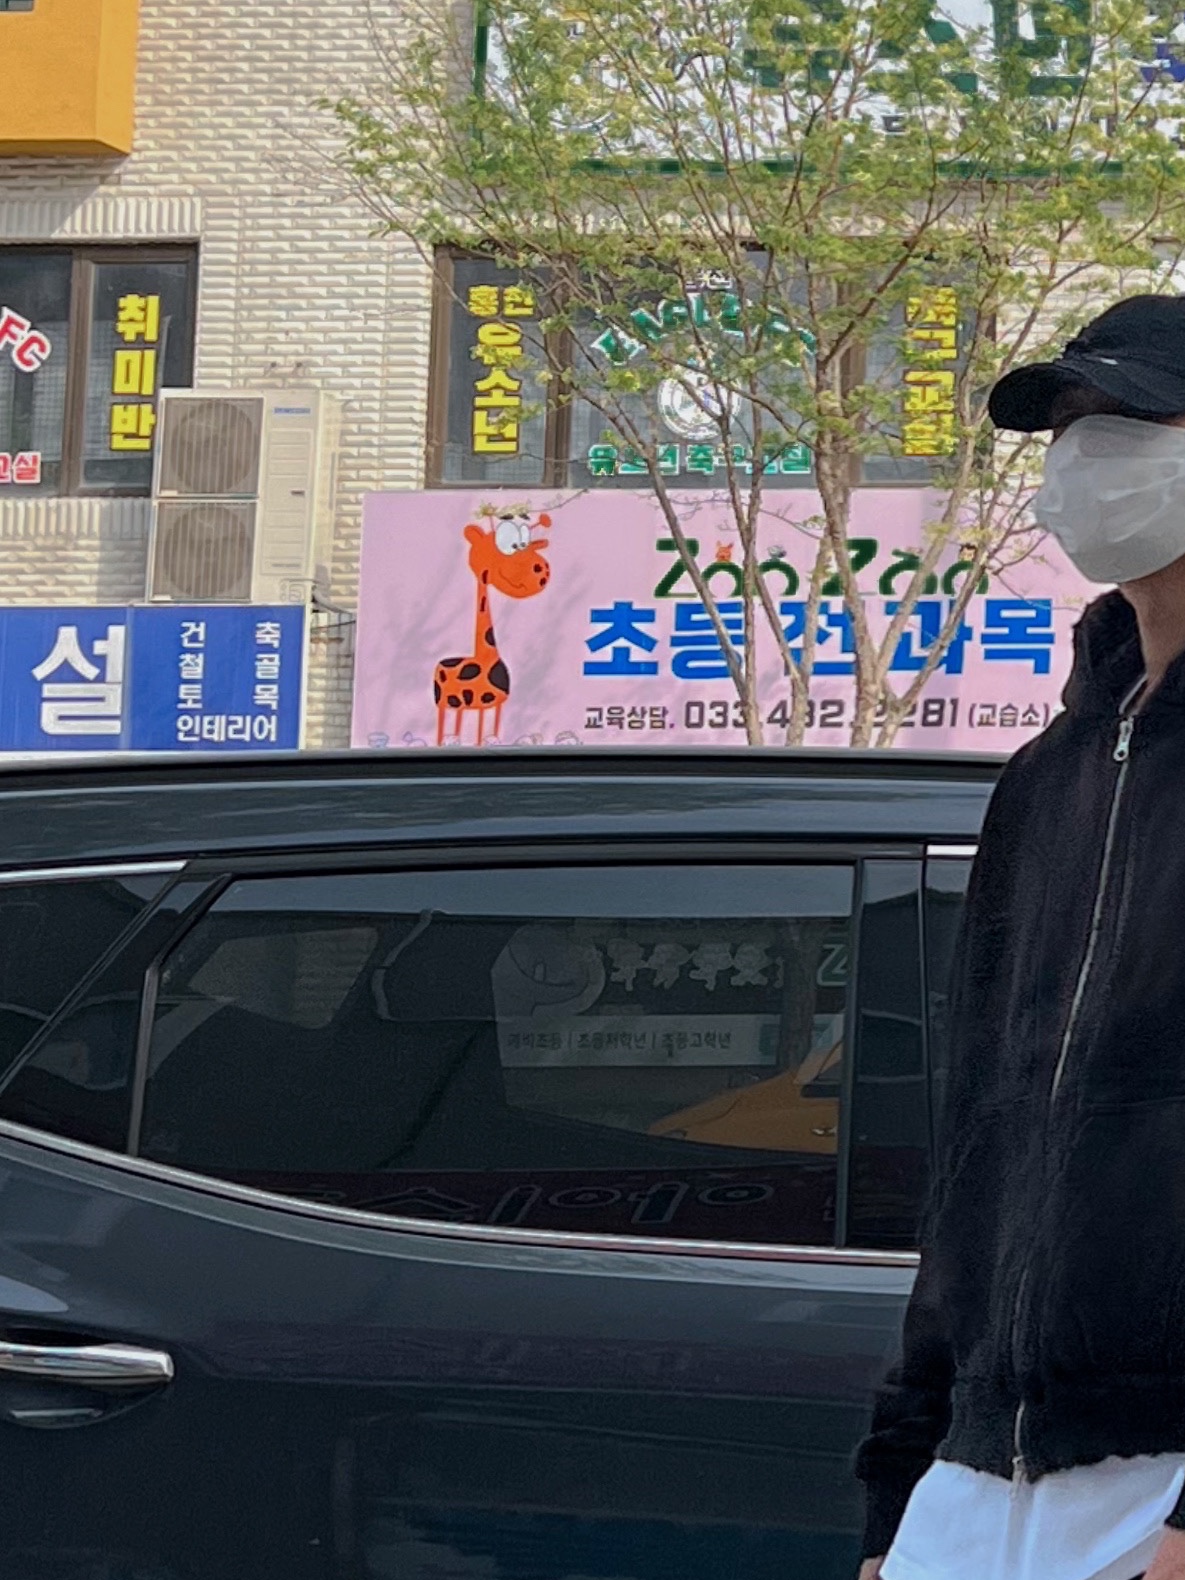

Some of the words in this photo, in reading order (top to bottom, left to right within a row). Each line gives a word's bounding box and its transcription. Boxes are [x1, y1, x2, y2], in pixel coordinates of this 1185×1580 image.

[0, 306, 52, 373] FC
[109, 293, 161, 452] 취미반
[471, 322, 523, 455] 유소년
[31, 624, 127, 736] 설
[583, 599, 746, 680] 초등
[176, 713, 278, 744] 인테리어
